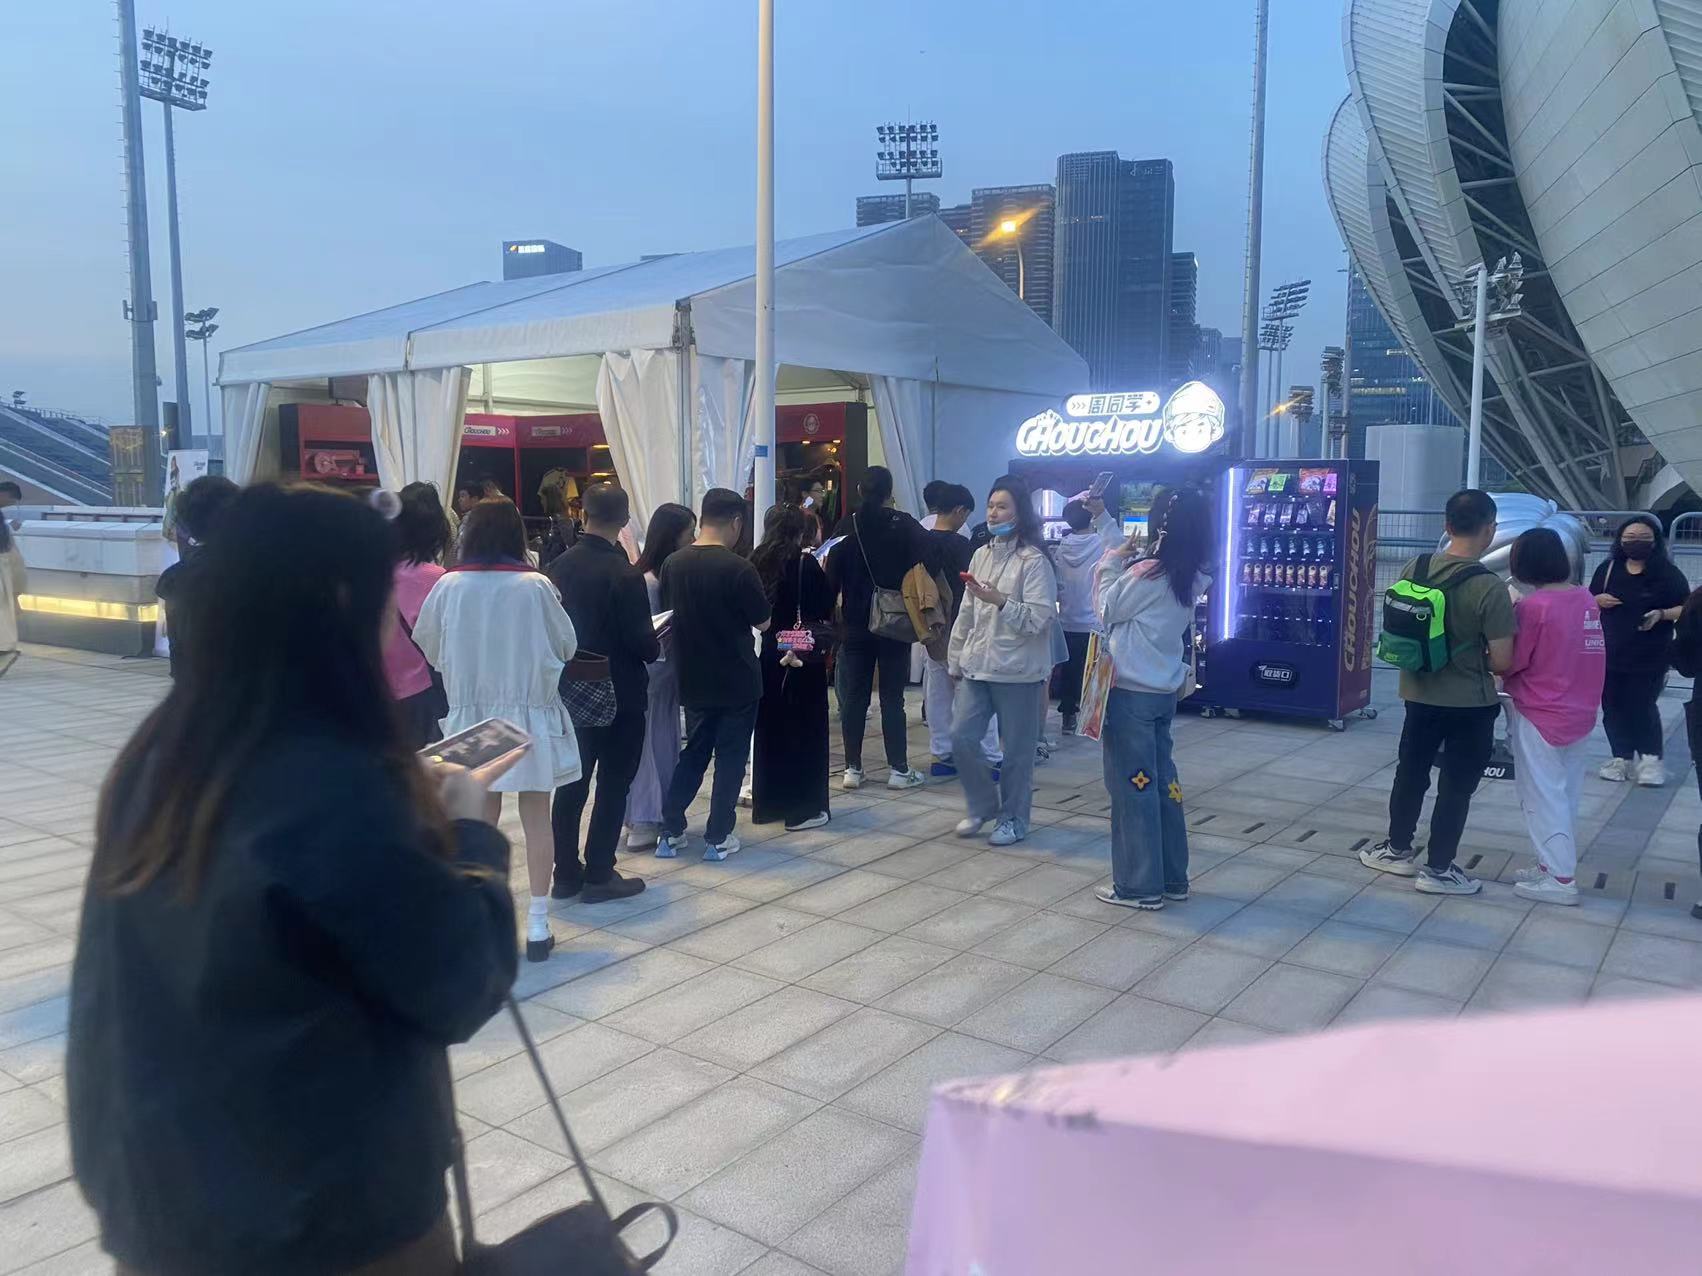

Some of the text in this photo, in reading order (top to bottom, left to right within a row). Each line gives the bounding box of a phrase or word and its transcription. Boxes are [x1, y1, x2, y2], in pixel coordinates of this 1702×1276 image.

[1088, 394, 1144, 415] 周同学
[1016, 410, 1165, 456] CHOUCHOU
[1344, 507, 1361, 672] CHOUCHOU
